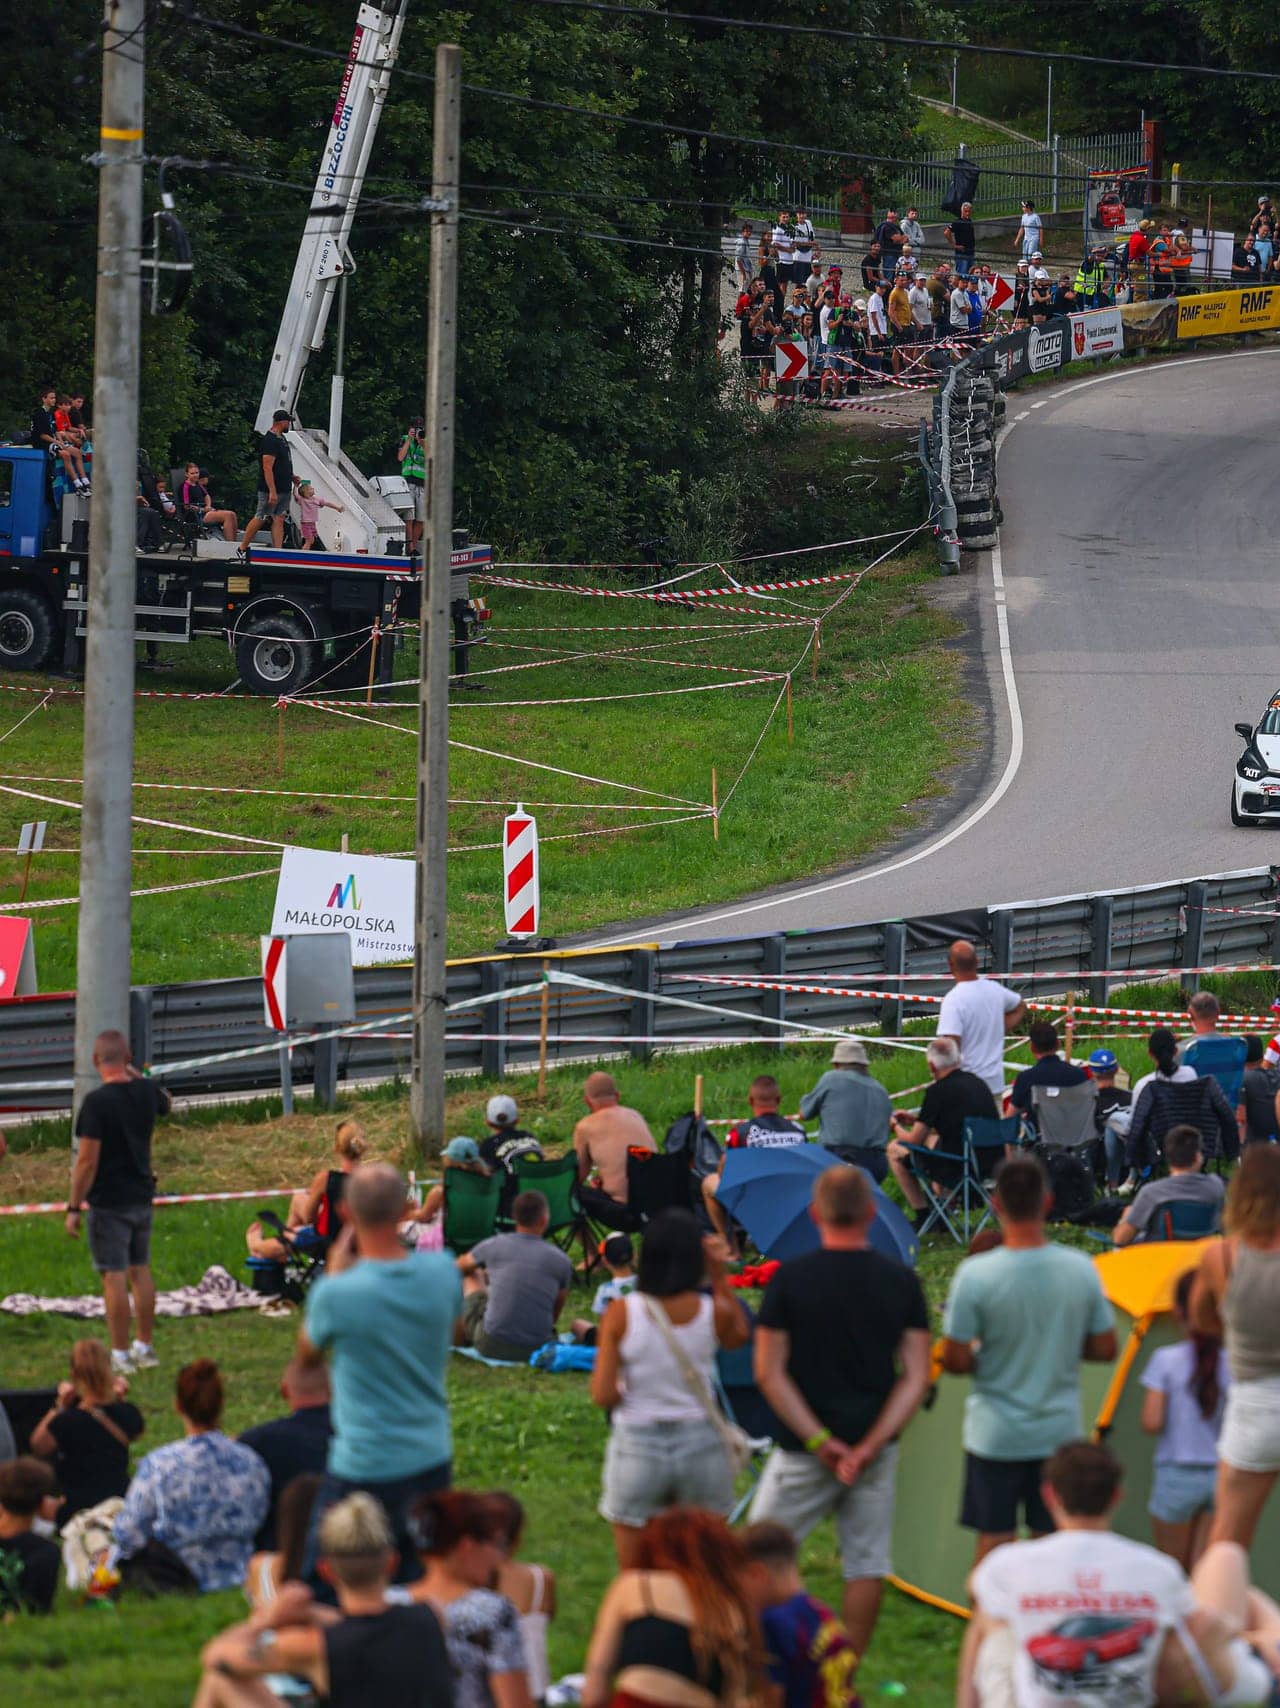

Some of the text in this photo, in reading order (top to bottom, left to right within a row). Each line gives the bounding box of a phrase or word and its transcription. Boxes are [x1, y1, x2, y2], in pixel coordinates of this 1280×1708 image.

[324, 104, 353, 189] BIZZOCCHI
[1240, 290, 1273, 314] RMF
[1180, 305, 1202, 322] RMF
[1034, 334, 1062, 355] MOTO
[1246, 768, 1261, 779] KIT
[285, 910, 395, 933] MAŁOPOLSKA
